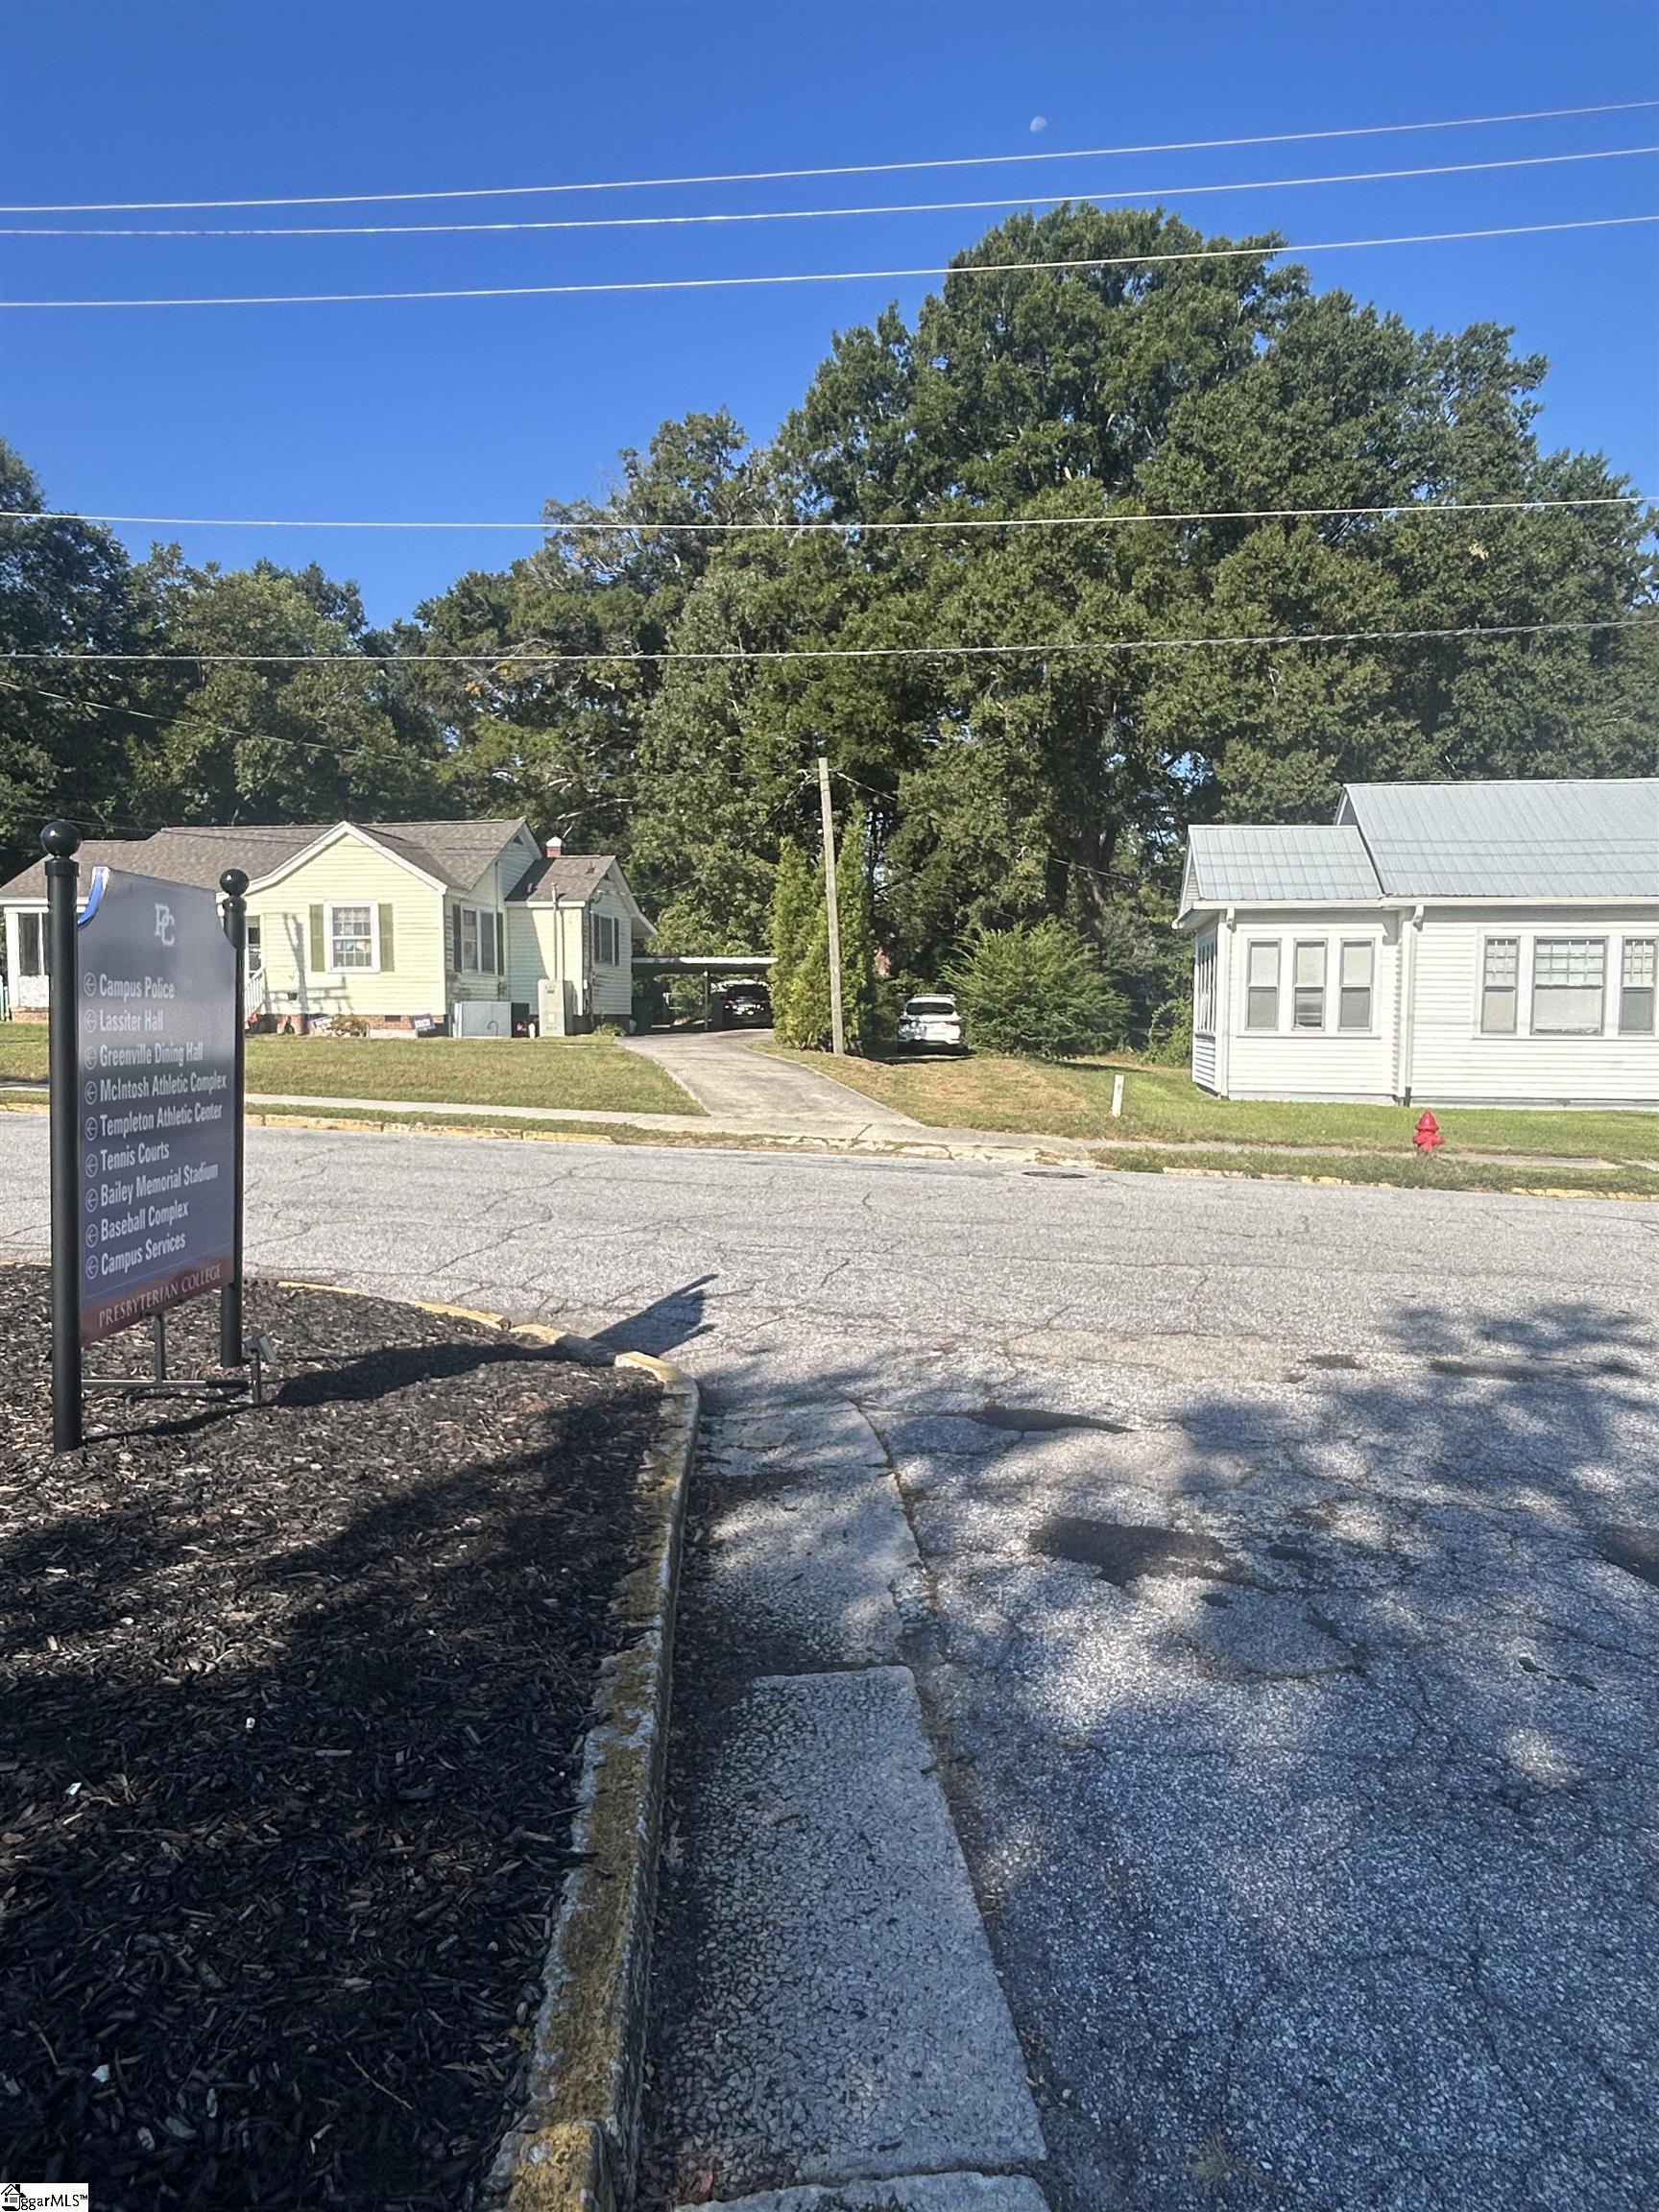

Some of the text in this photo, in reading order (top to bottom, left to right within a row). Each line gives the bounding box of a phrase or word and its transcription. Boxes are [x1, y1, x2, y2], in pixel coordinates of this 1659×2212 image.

[99, 974, 175, 1000] Campus Police
[100, 1010, 163, 1032] Lassiter Hall
[100, 1042, 203, 1068] Greenville Dining Hall
[100, 1070, 228, 1102] McIntosh Athletic Complex
[100, 1102, 223, 1139] Templeton Athletic Center
[100, 1142, 170, 1172] Tennis Courts
[101, 1161, 219, 1207] Bailey Memorial Stadium
[101, 1199, 189, 1241] Baseball Complex
[101, 1232, 186, 1276] Campus Services
[99, 1264, 221, 1328] PRESBYTERIAN COLLEGE
